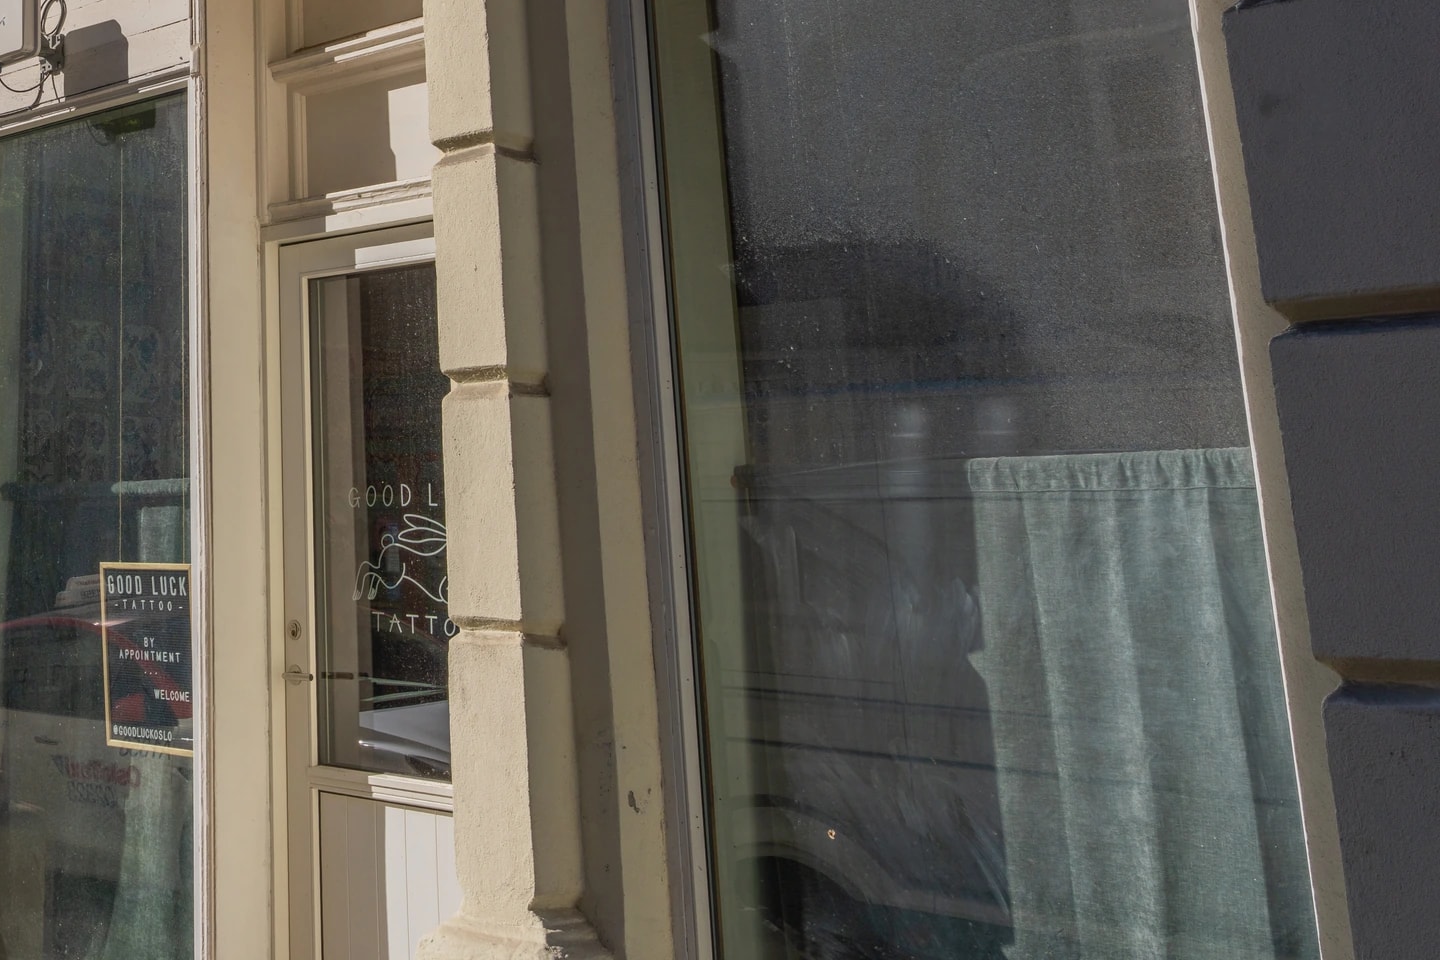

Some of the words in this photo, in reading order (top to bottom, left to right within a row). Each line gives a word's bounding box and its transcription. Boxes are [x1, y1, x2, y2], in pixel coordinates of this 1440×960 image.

[348, 483, 412, 508] GOOD
[107, 574, 143, 595] GOOD
[151, 575, 187, 597] LUCK
[372, 611, 456, 637] TATTO
[143, 637, 155, 648] BY
[119, 649, 181, 663] APPOINTMENT
[153, 688, 190, 702] WELCOME
[113, 725, 172, 741] @GOODLUCKOSLO
